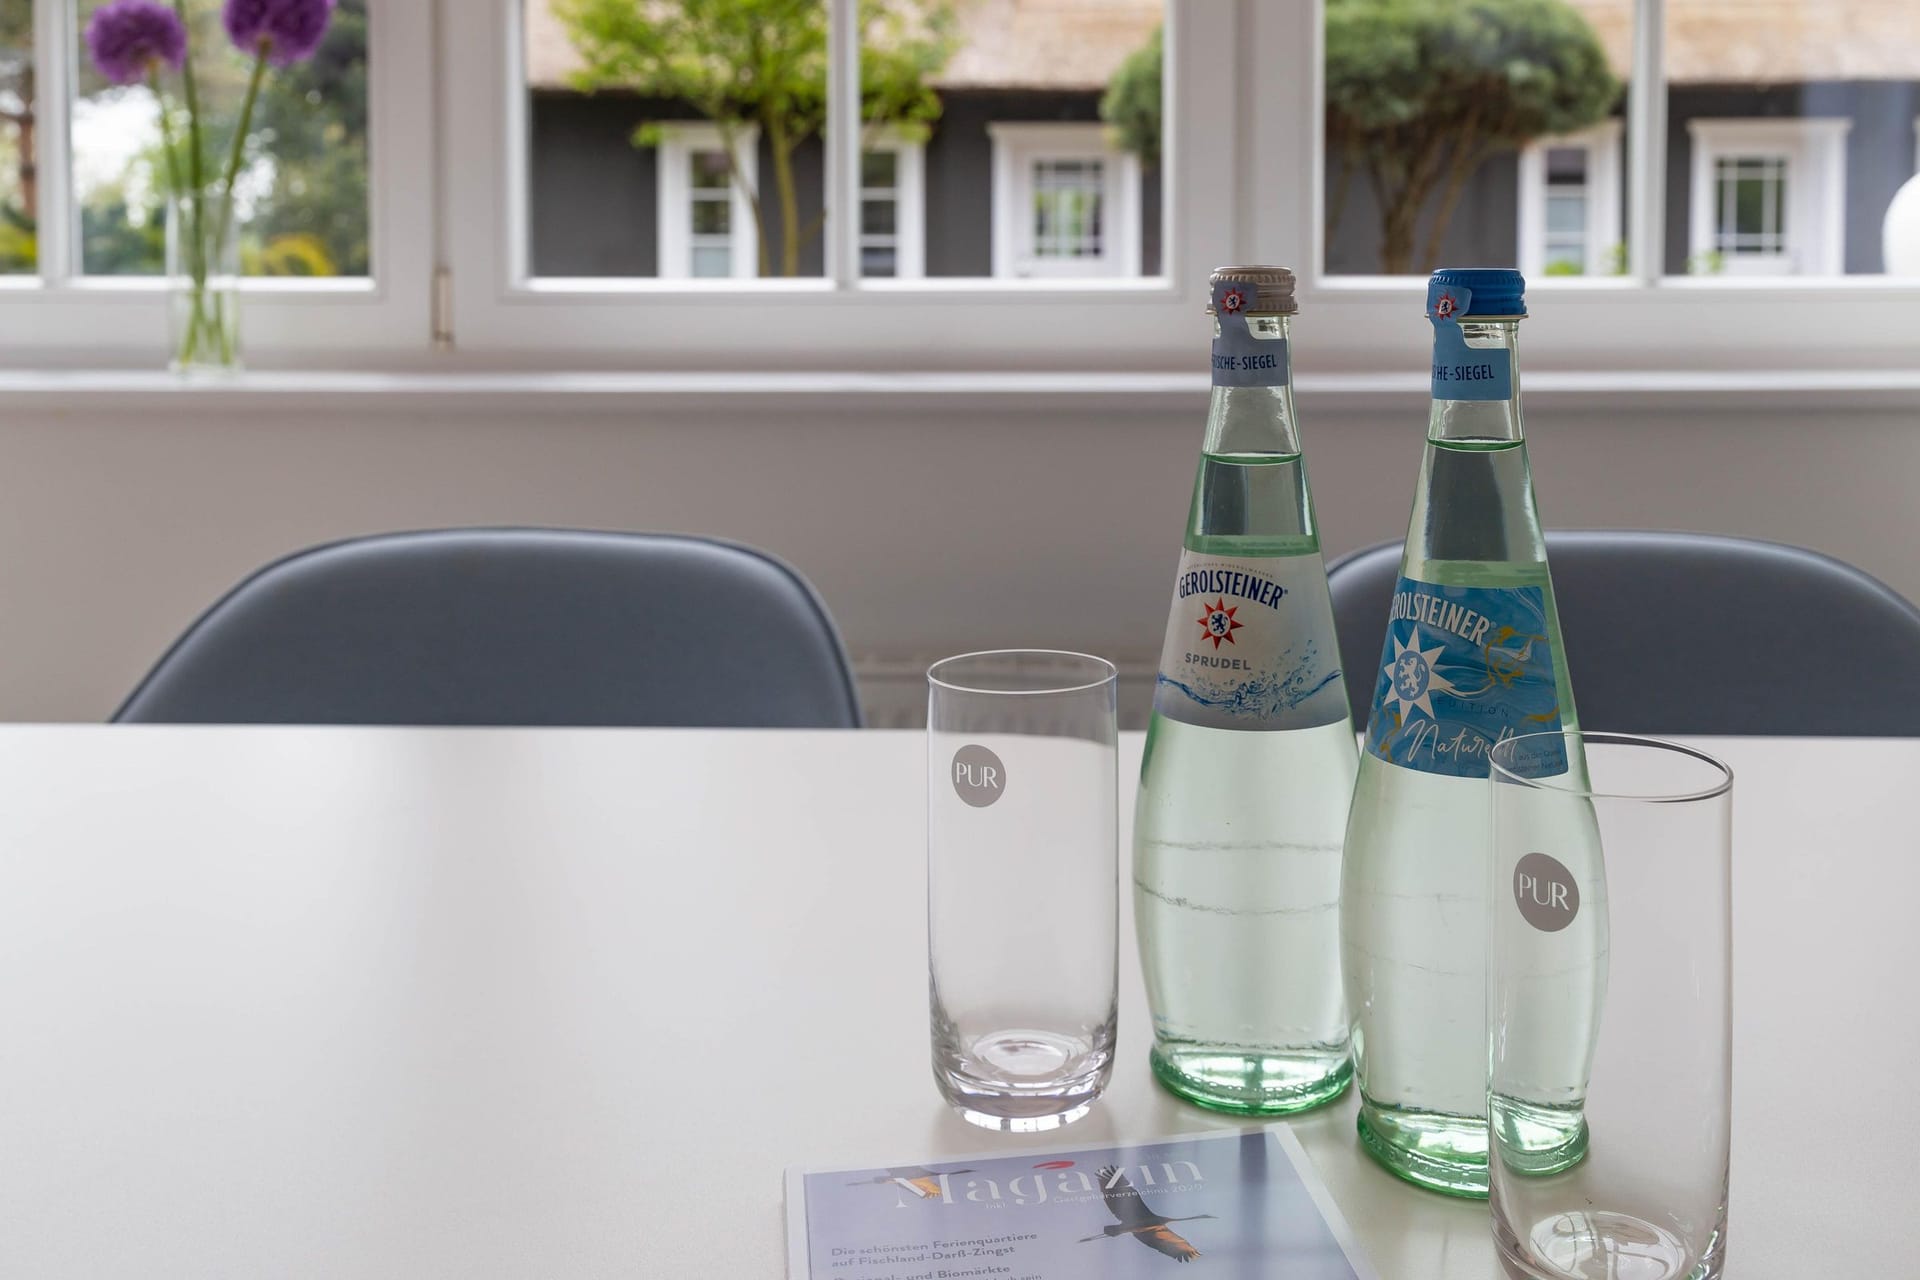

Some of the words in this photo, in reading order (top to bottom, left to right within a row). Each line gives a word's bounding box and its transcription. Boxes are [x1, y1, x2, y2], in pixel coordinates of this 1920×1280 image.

[1179, 570, 1284, 610] GEROLSTEINER
[1185, 652, 1252, 671] SPRUDEL
[956, 762, 998, 789] PUR
[1519, 872, 1570, 911] PUR
[895, 1160, 1204, 1208] Magazin
[831, 1247, 856, 1257] Die
[859, 1244, 929, 1255] schönsten
[932, 1233, 1037, 1249] Ferienquartiere
[831, 1257, 855, 1268] auf
[937, 1266, 1011, 1279] Biomärkte
